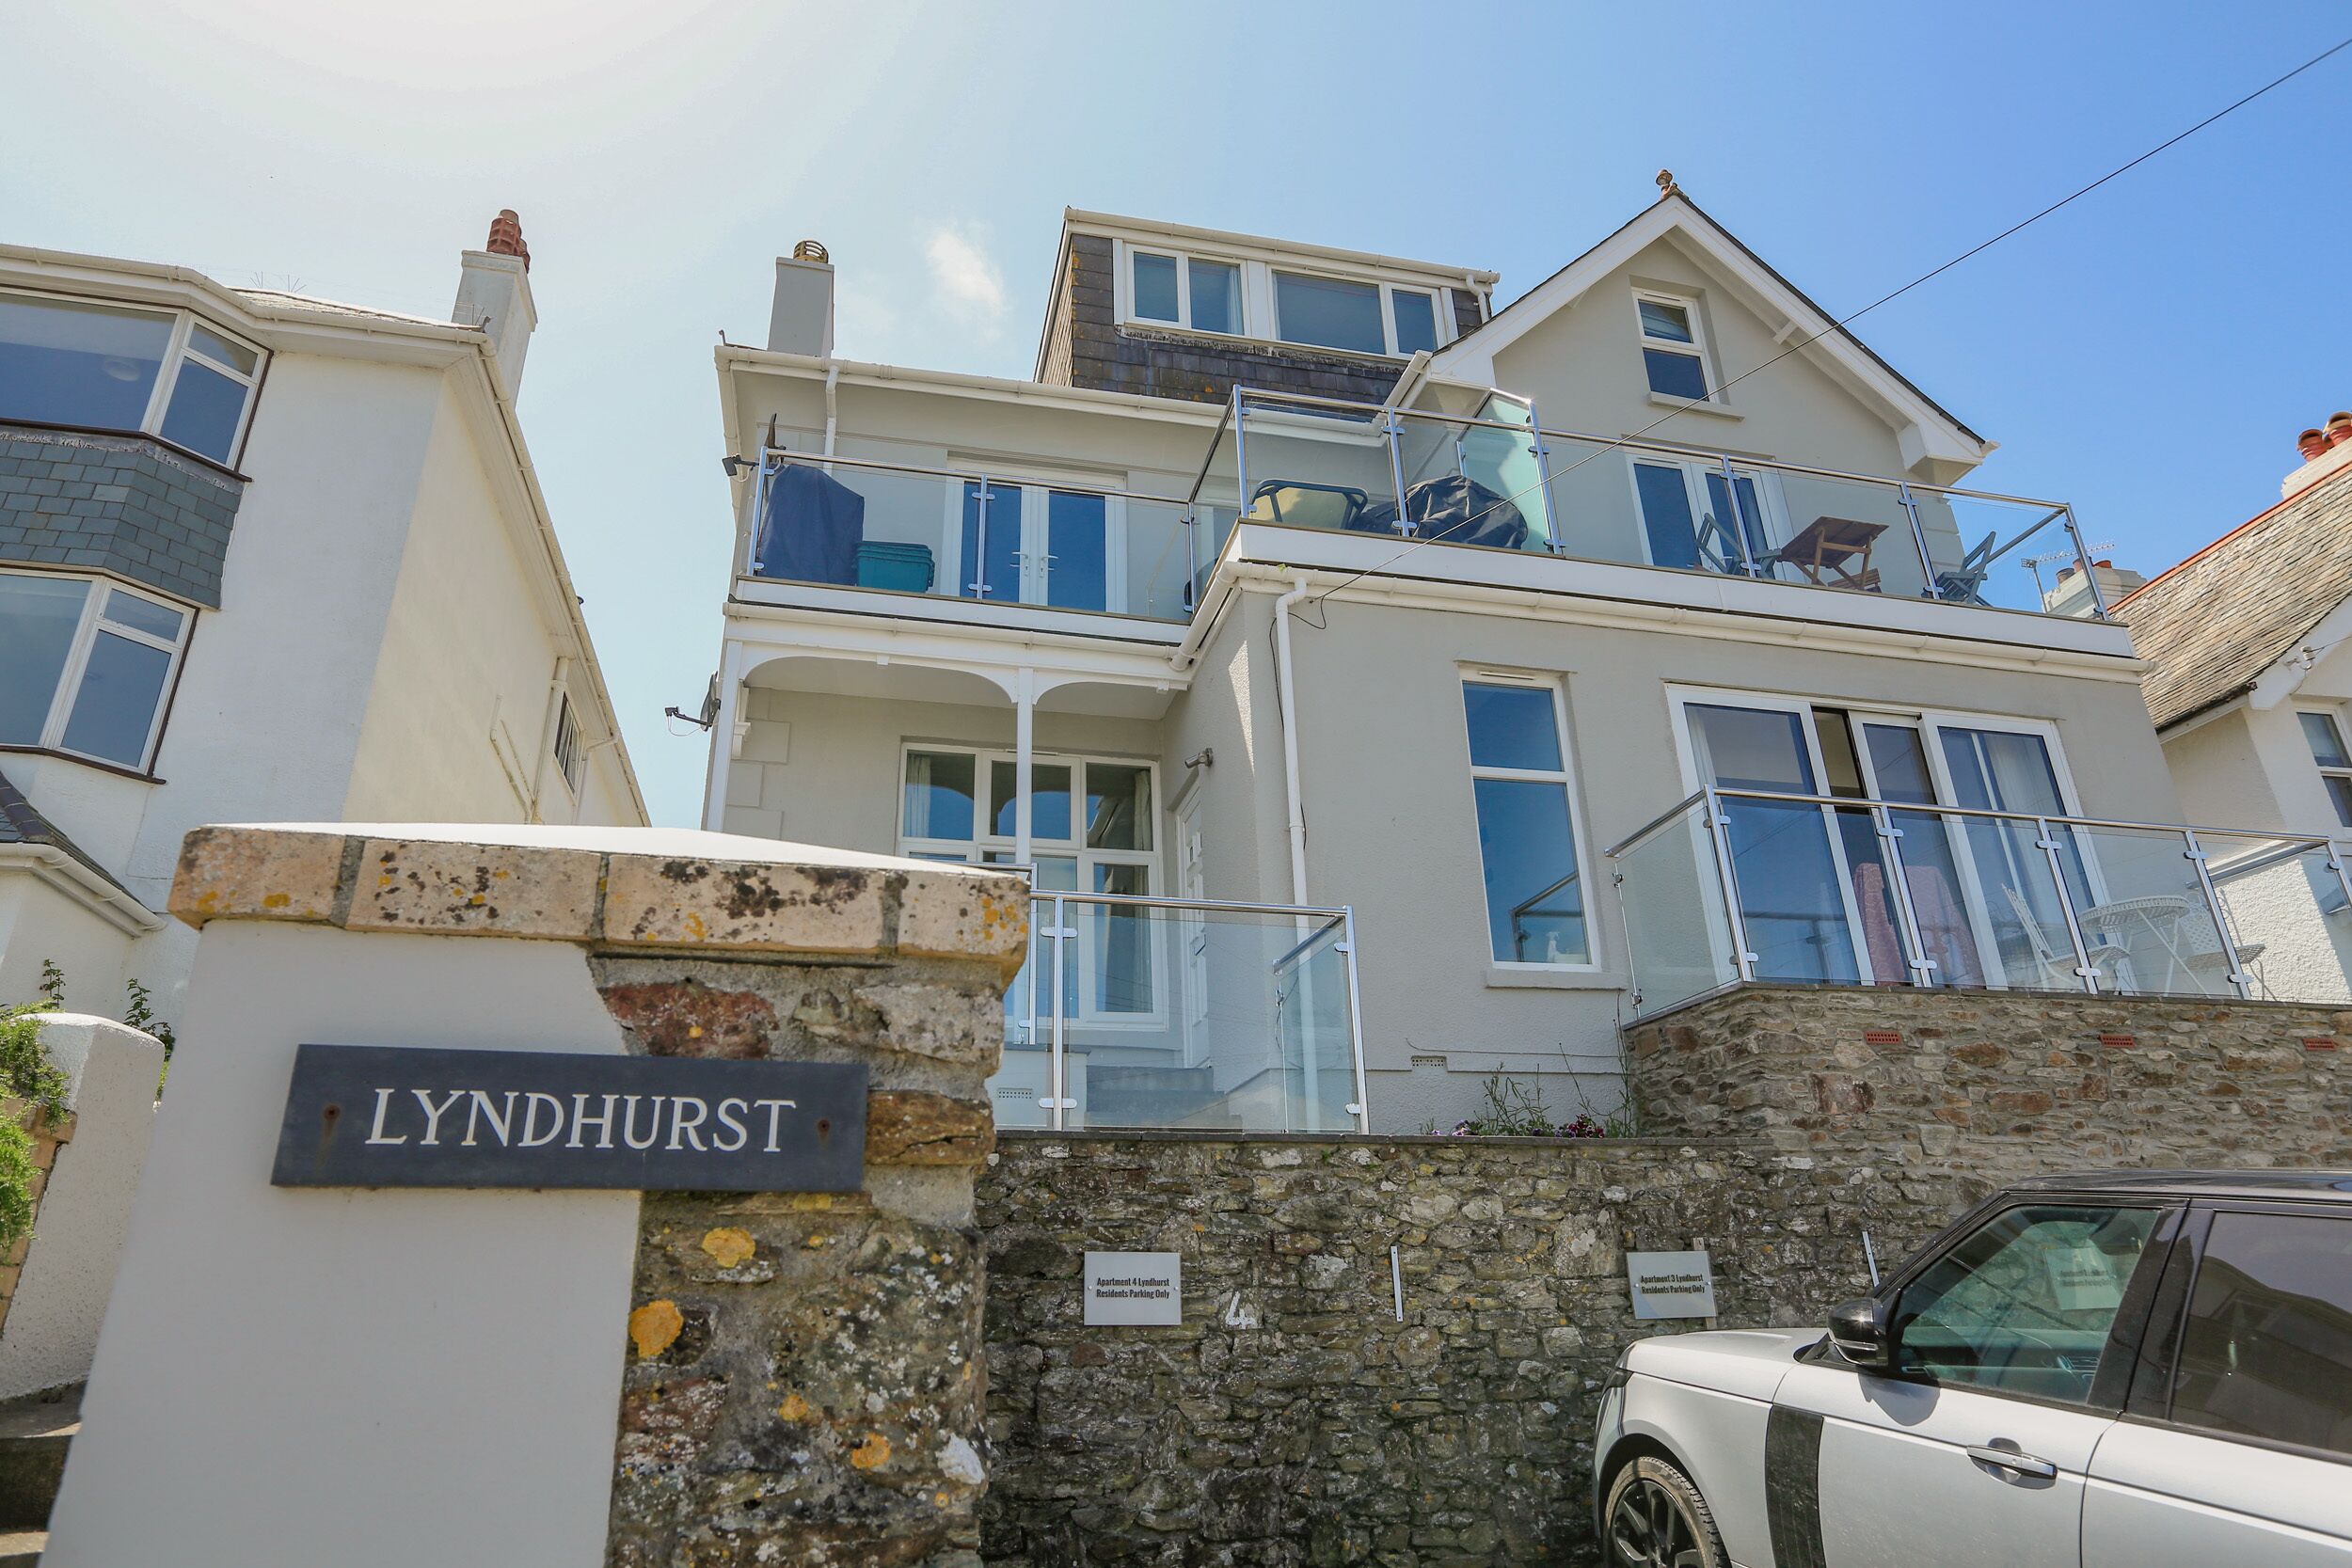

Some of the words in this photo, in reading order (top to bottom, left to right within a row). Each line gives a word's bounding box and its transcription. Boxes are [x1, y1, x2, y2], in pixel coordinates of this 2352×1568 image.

[365, 1088, 797, 1152] LYNDHURST
[1097, 1277, 1131, 1287] Apartment
[1133, 1277, 1137, 1286] 4
[1138, 1277, 1169, 1287] Lyndhurst
[1640, 1275, 1671, 1284] Apartment
[1676, 1274, 1704, 1283] Lyndhurst
[1096, 1290, 1129, 1298] Residents
[1130, 1290, 1154, 1299] Parking
[1155, 1290, 1170, 1299] Only
[1641, 1286, 1670, 1294] Residents
[1670, 1285, 1692, 1293] Parking
[1692, 1285, 1705, 1293] Only
